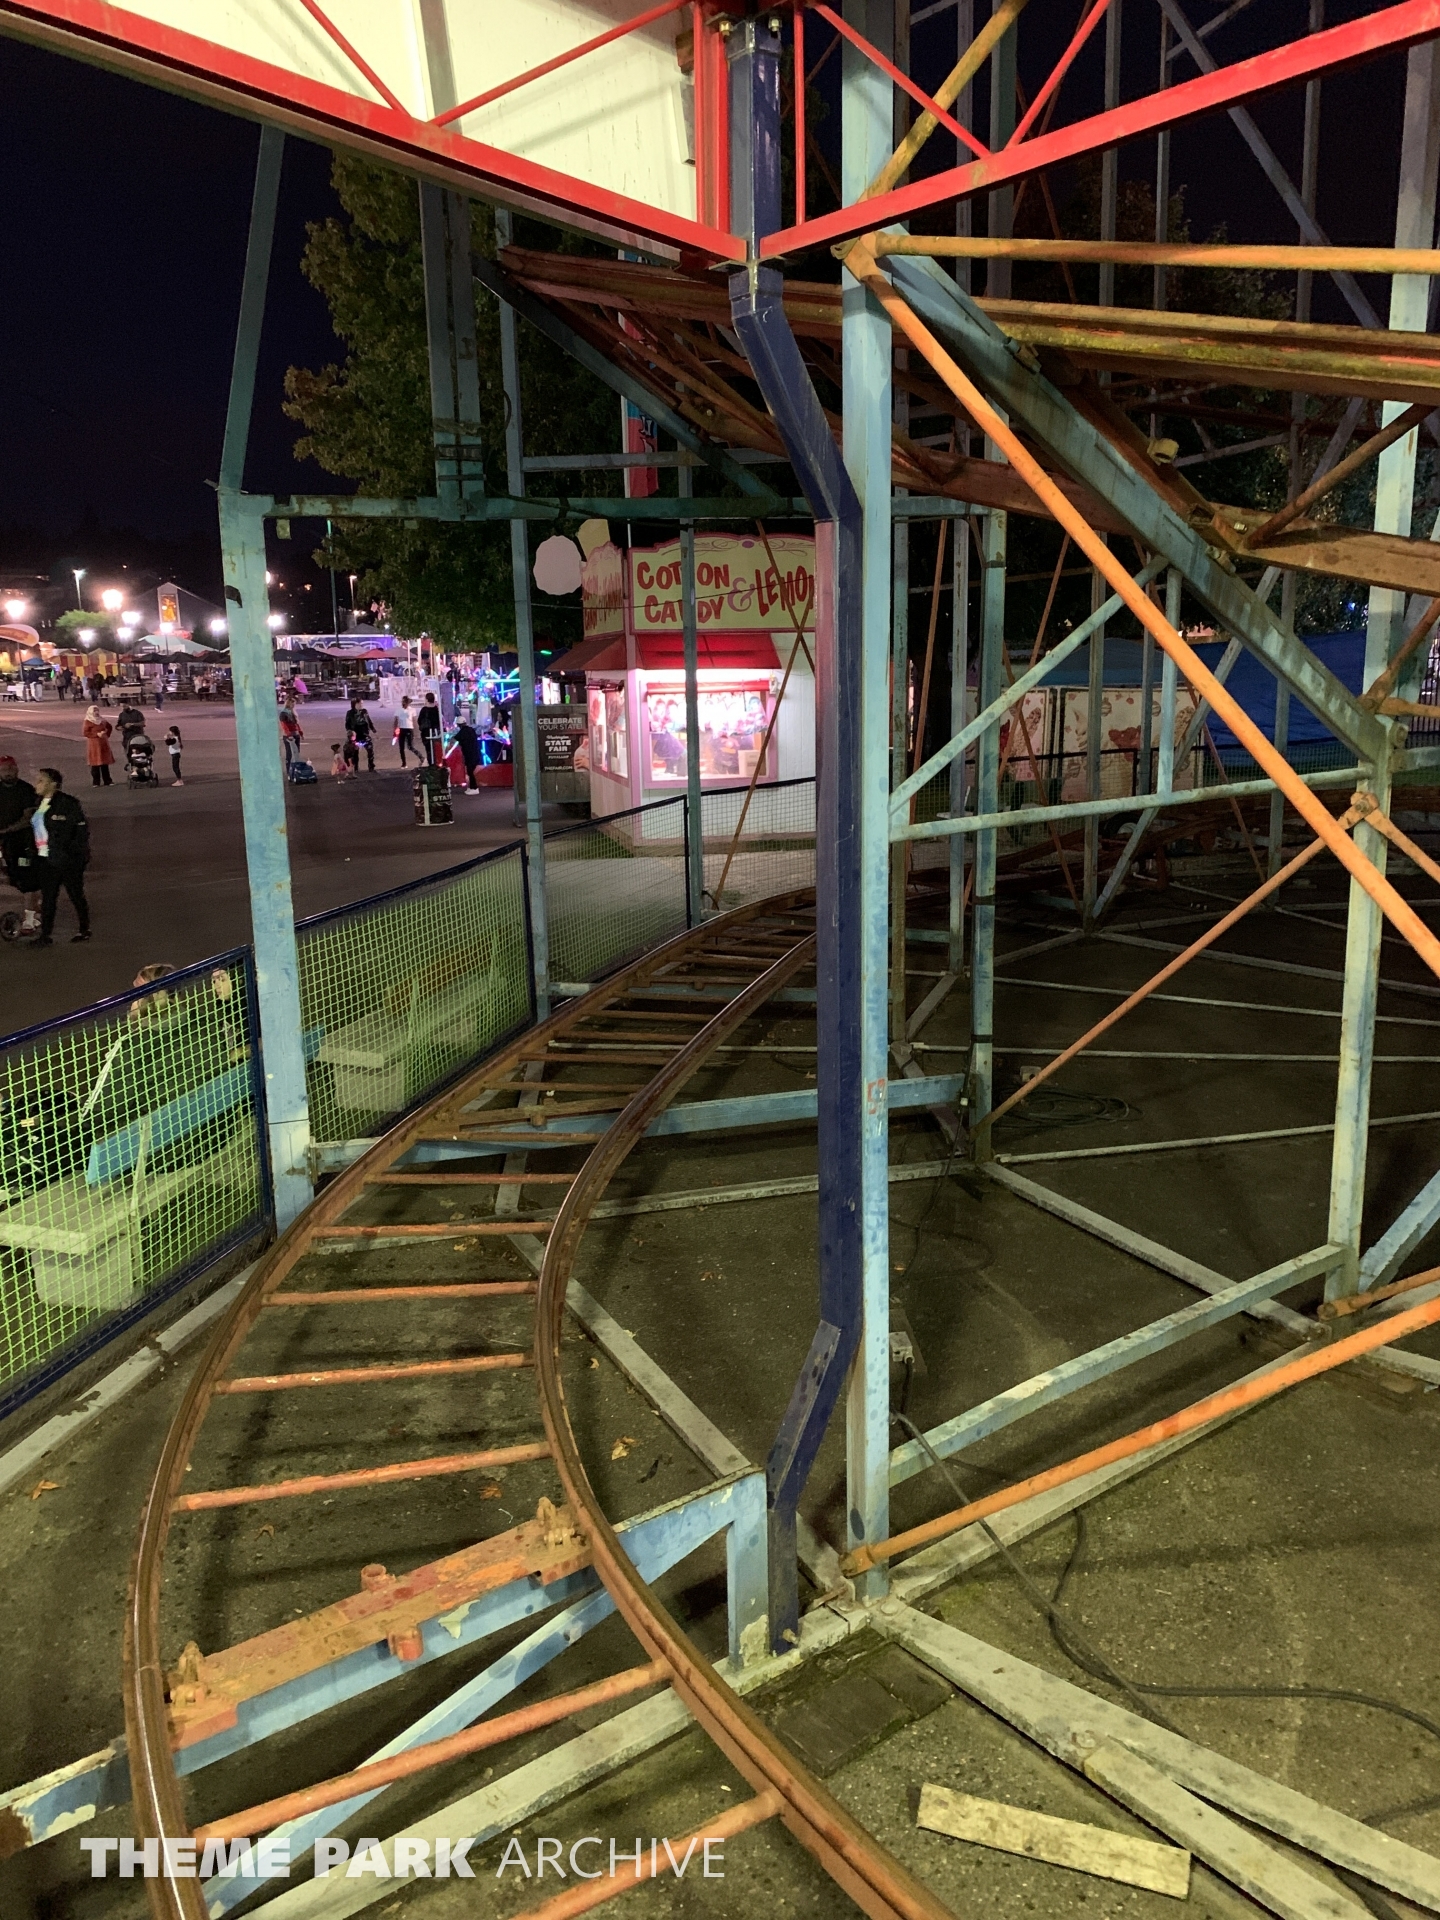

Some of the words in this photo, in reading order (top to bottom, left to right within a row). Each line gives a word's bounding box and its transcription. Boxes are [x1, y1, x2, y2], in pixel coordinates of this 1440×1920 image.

[637, 561, 730, 590] COTON
[644, 594, 725, 624] CADY
[727, 577, 755, 612] &
